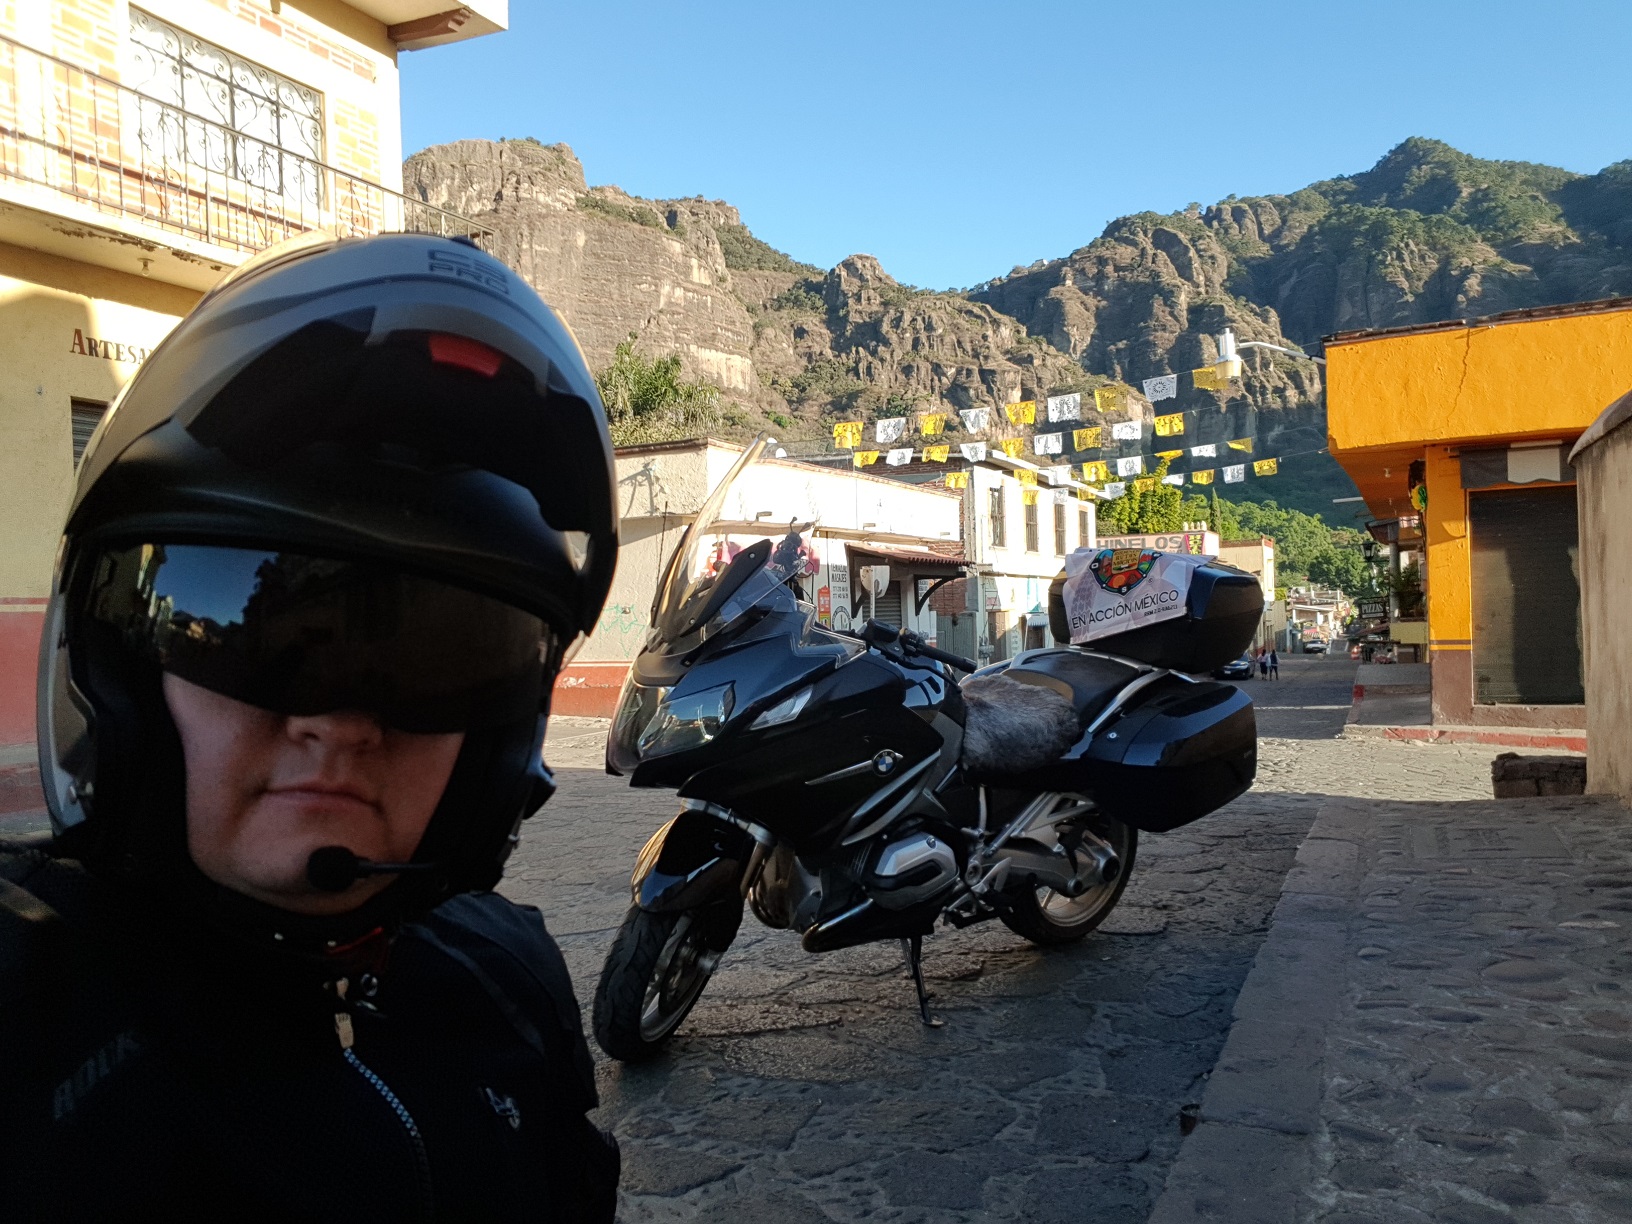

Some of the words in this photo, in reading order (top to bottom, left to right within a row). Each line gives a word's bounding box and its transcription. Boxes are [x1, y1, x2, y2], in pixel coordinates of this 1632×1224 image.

[428, 262, 511, 295] PRO
[69, 328, 154, 365] ARTESA
[1071, 614, 1087, 629] EN
[1088, 601, 1132, 625] ACCIÓN
[1133, 590, 1179, 611] MÉXICO
[1361, 603, 1384, 614] PIZZAS
